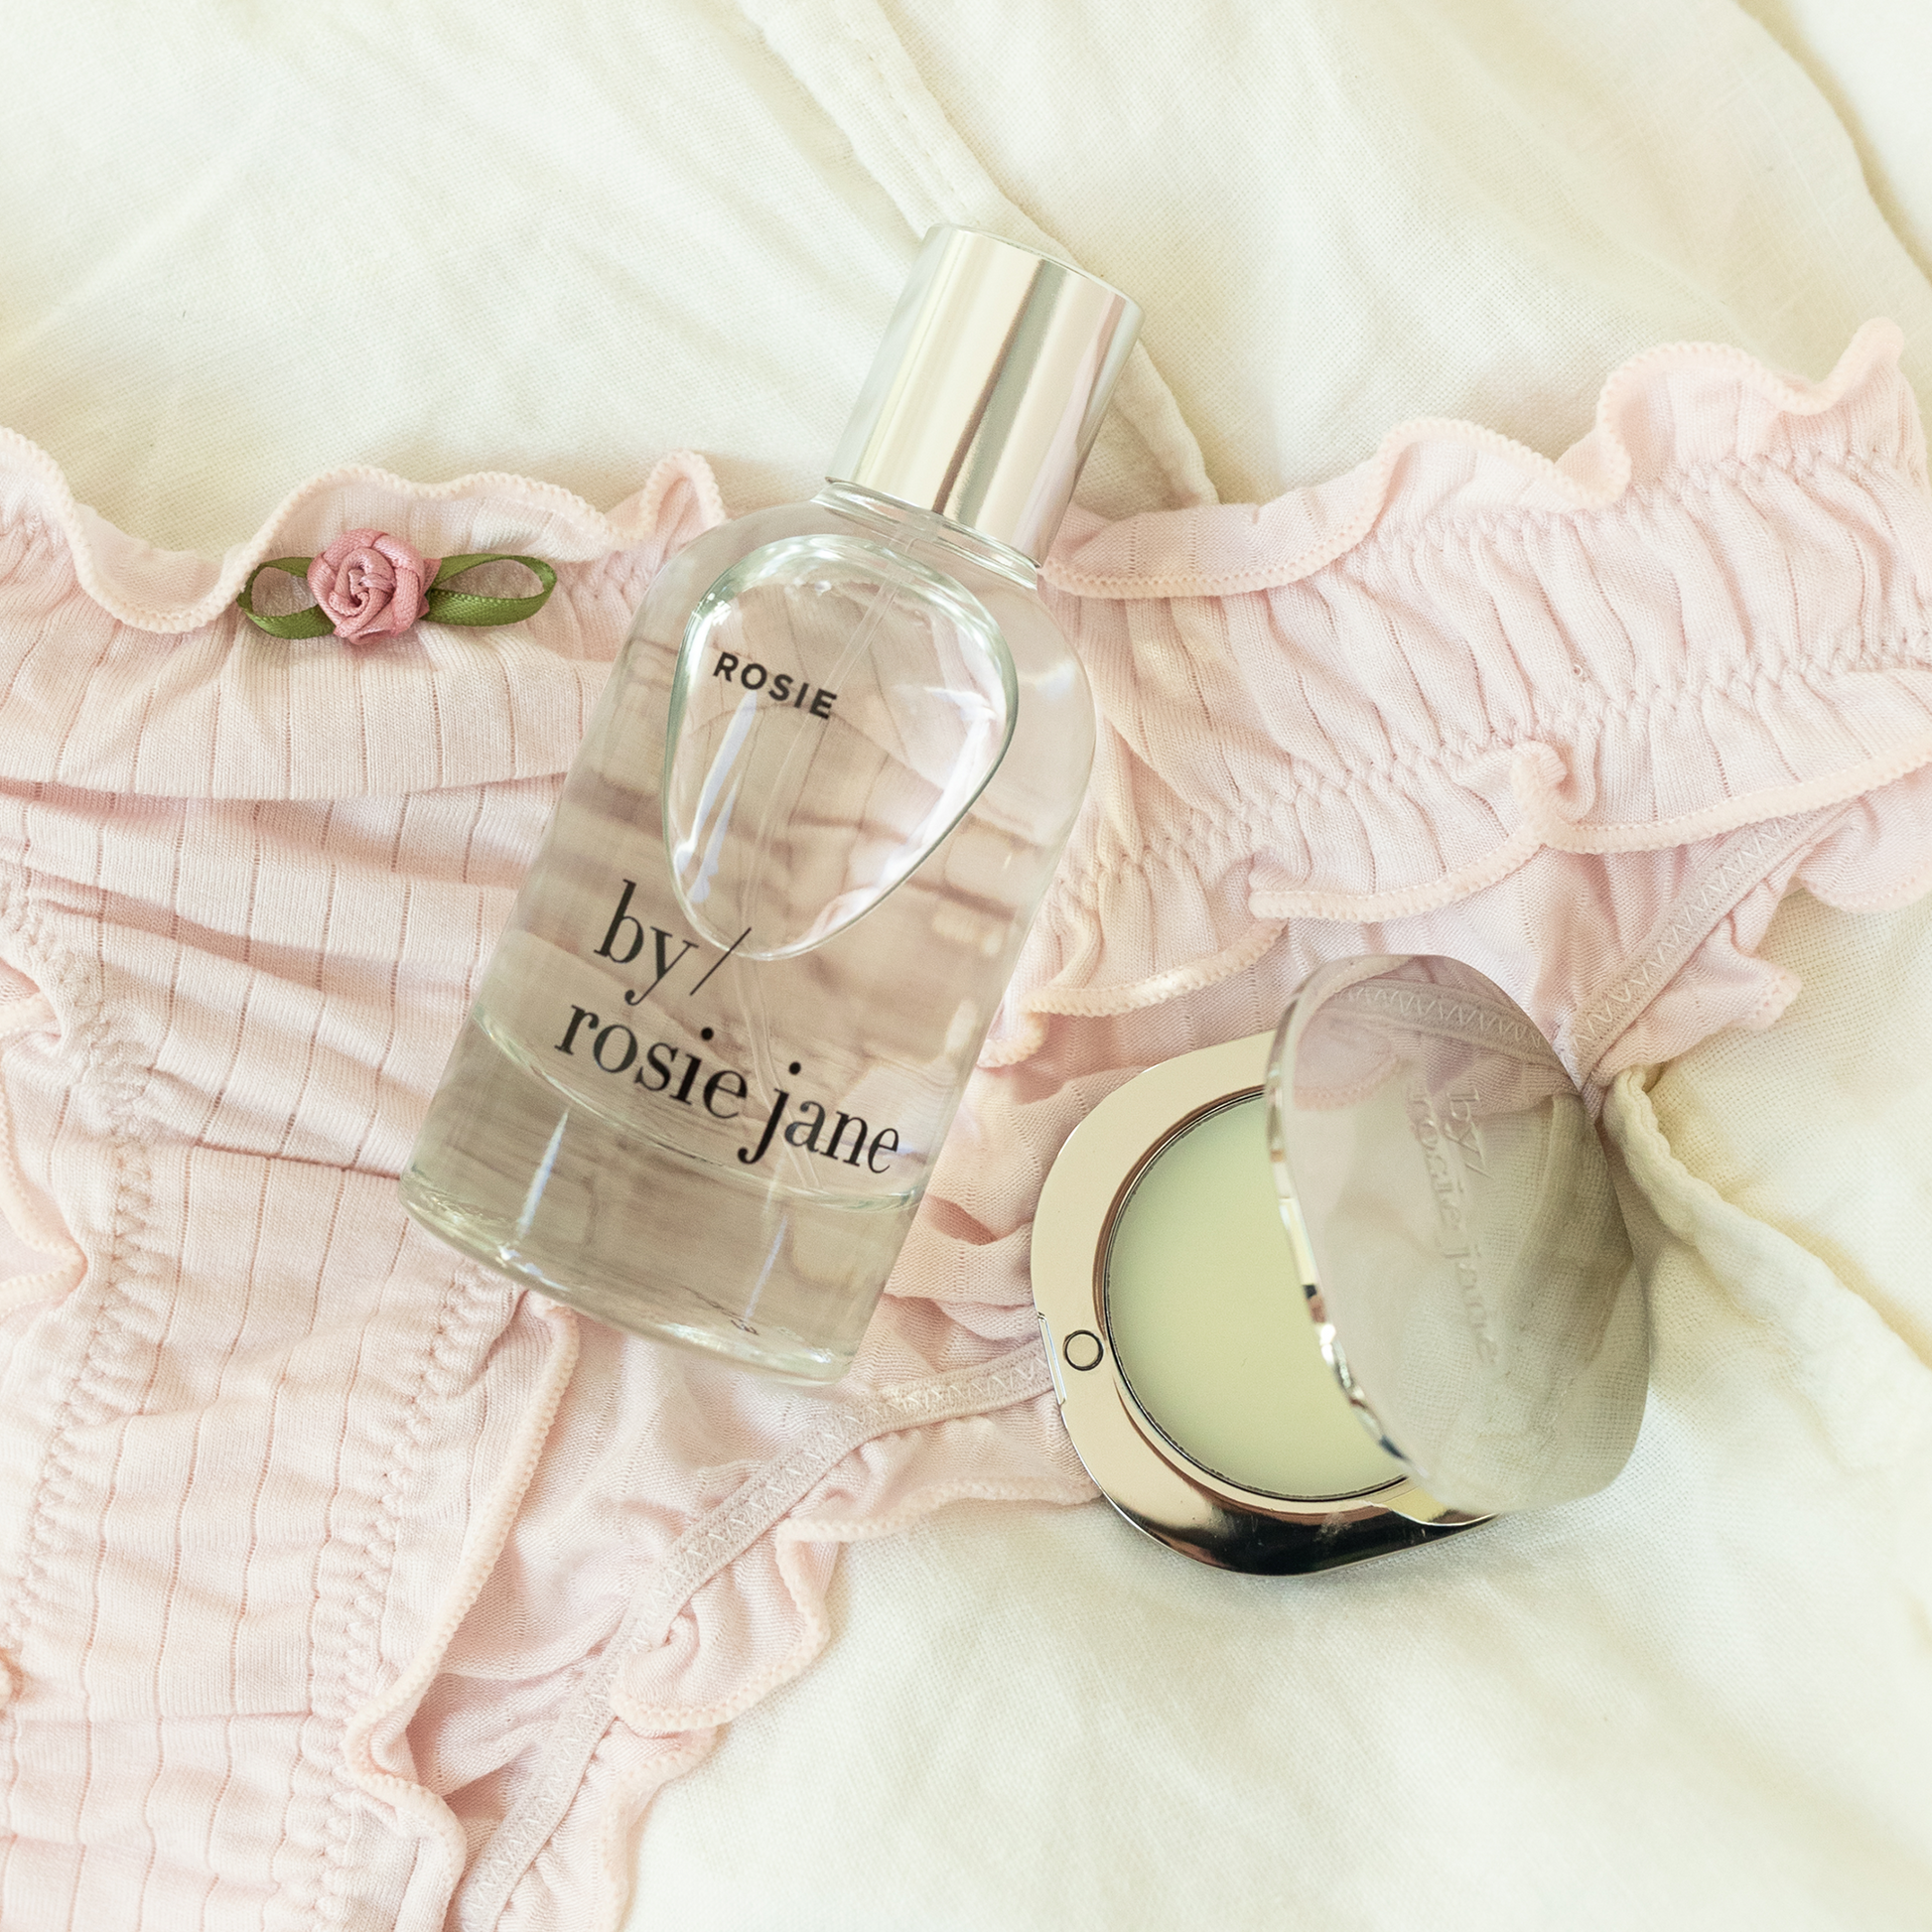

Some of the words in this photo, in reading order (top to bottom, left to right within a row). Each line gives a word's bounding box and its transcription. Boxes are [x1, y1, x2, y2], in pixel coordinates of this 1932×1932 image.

[713, 651, 838, 719] ROSIE
[554, 1004, 749, 1120] rosie
[737, 1061, 900, 1173] jane
